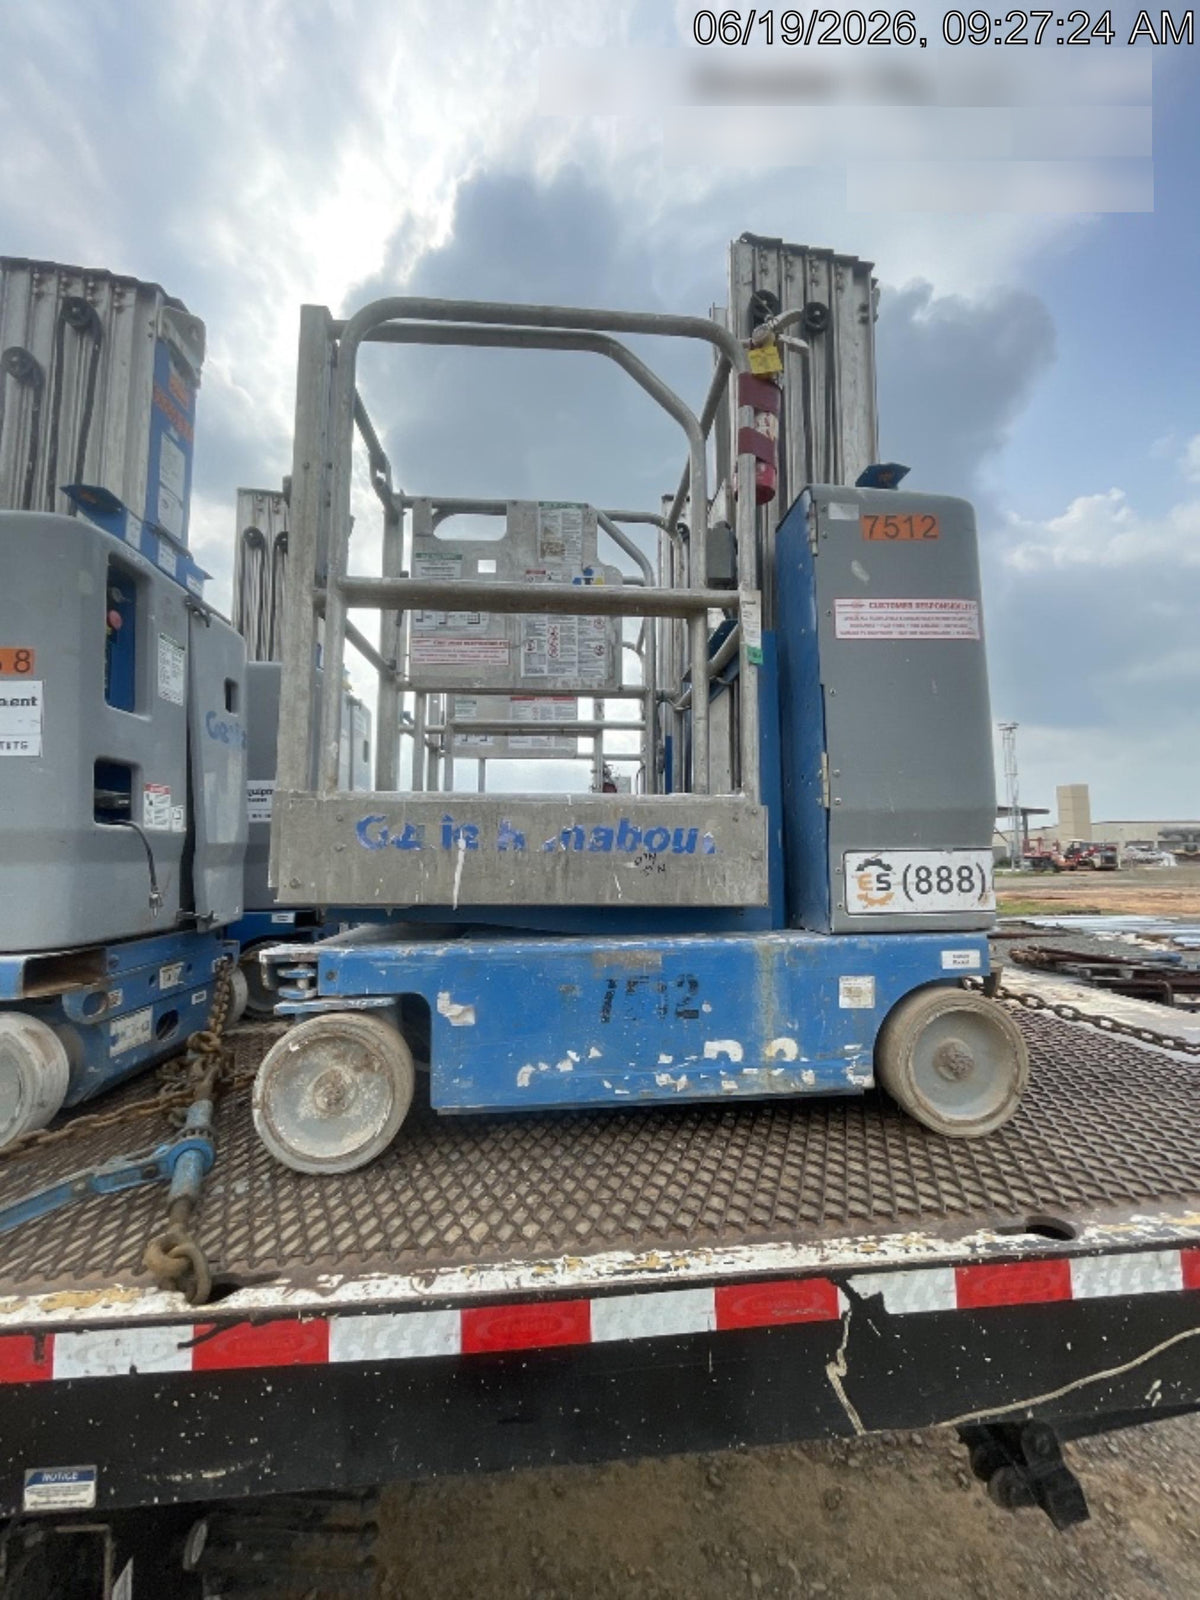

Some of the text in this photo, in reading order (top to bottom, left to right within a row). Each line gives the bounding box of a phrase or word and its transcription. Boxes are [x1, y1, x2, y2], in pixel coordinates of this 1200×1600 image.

[863, 514, 938, 539] 7512
[0, 649, 31, 673] 8
[355, 814, 716, 855] Geie nabou
[857, 862, 986, 902] ES (888)
[42, 1472, 78, 1482] NOTICE
